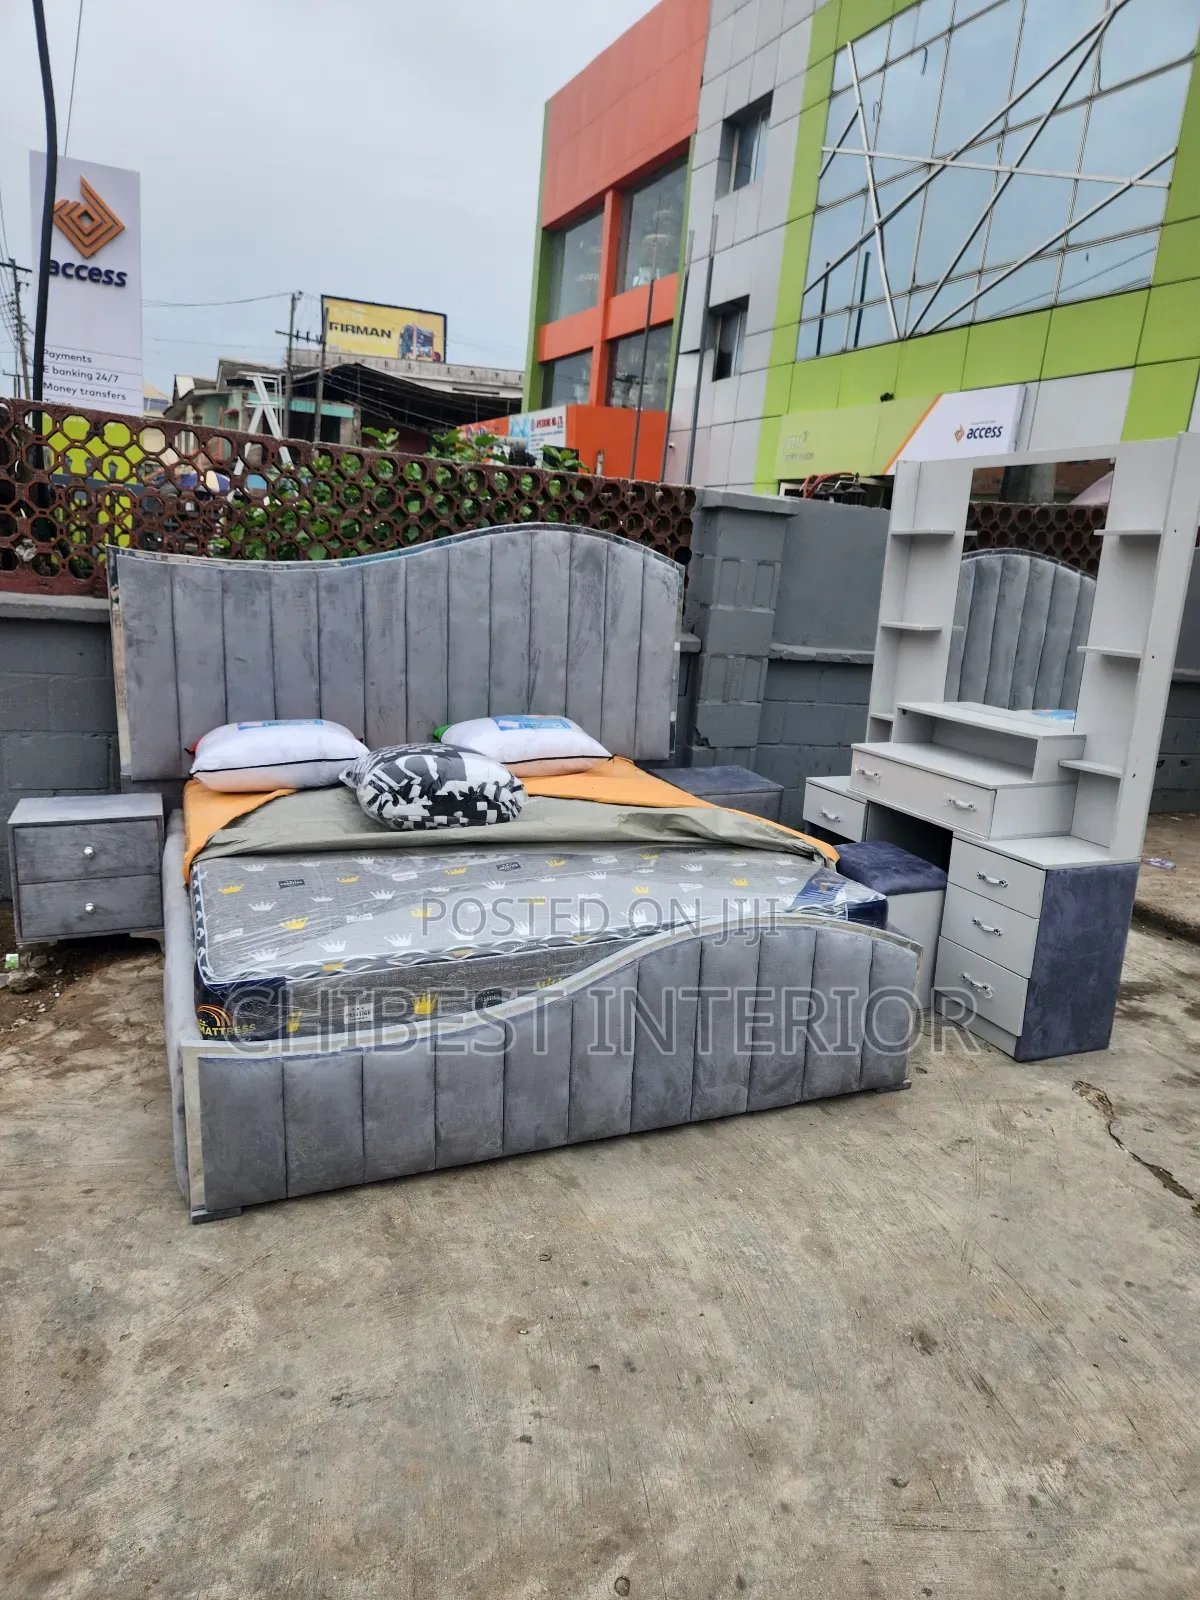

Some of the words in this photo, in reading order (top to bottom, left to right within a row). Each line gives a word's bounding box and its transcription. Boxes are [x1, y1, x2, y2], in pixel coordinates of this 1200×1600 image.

[48, 259, 128, 287] access
[329, 321, 392, 339] FIRMAN
[43, 348, 93, 363] Payments
[52, 366, 93, 382] banking
[95, 372, 119, 383] 24/7
[43, 382, 77, 395] Money
[80, 388, 127, 401] transfers
[966, 425, 1004, 440] access
